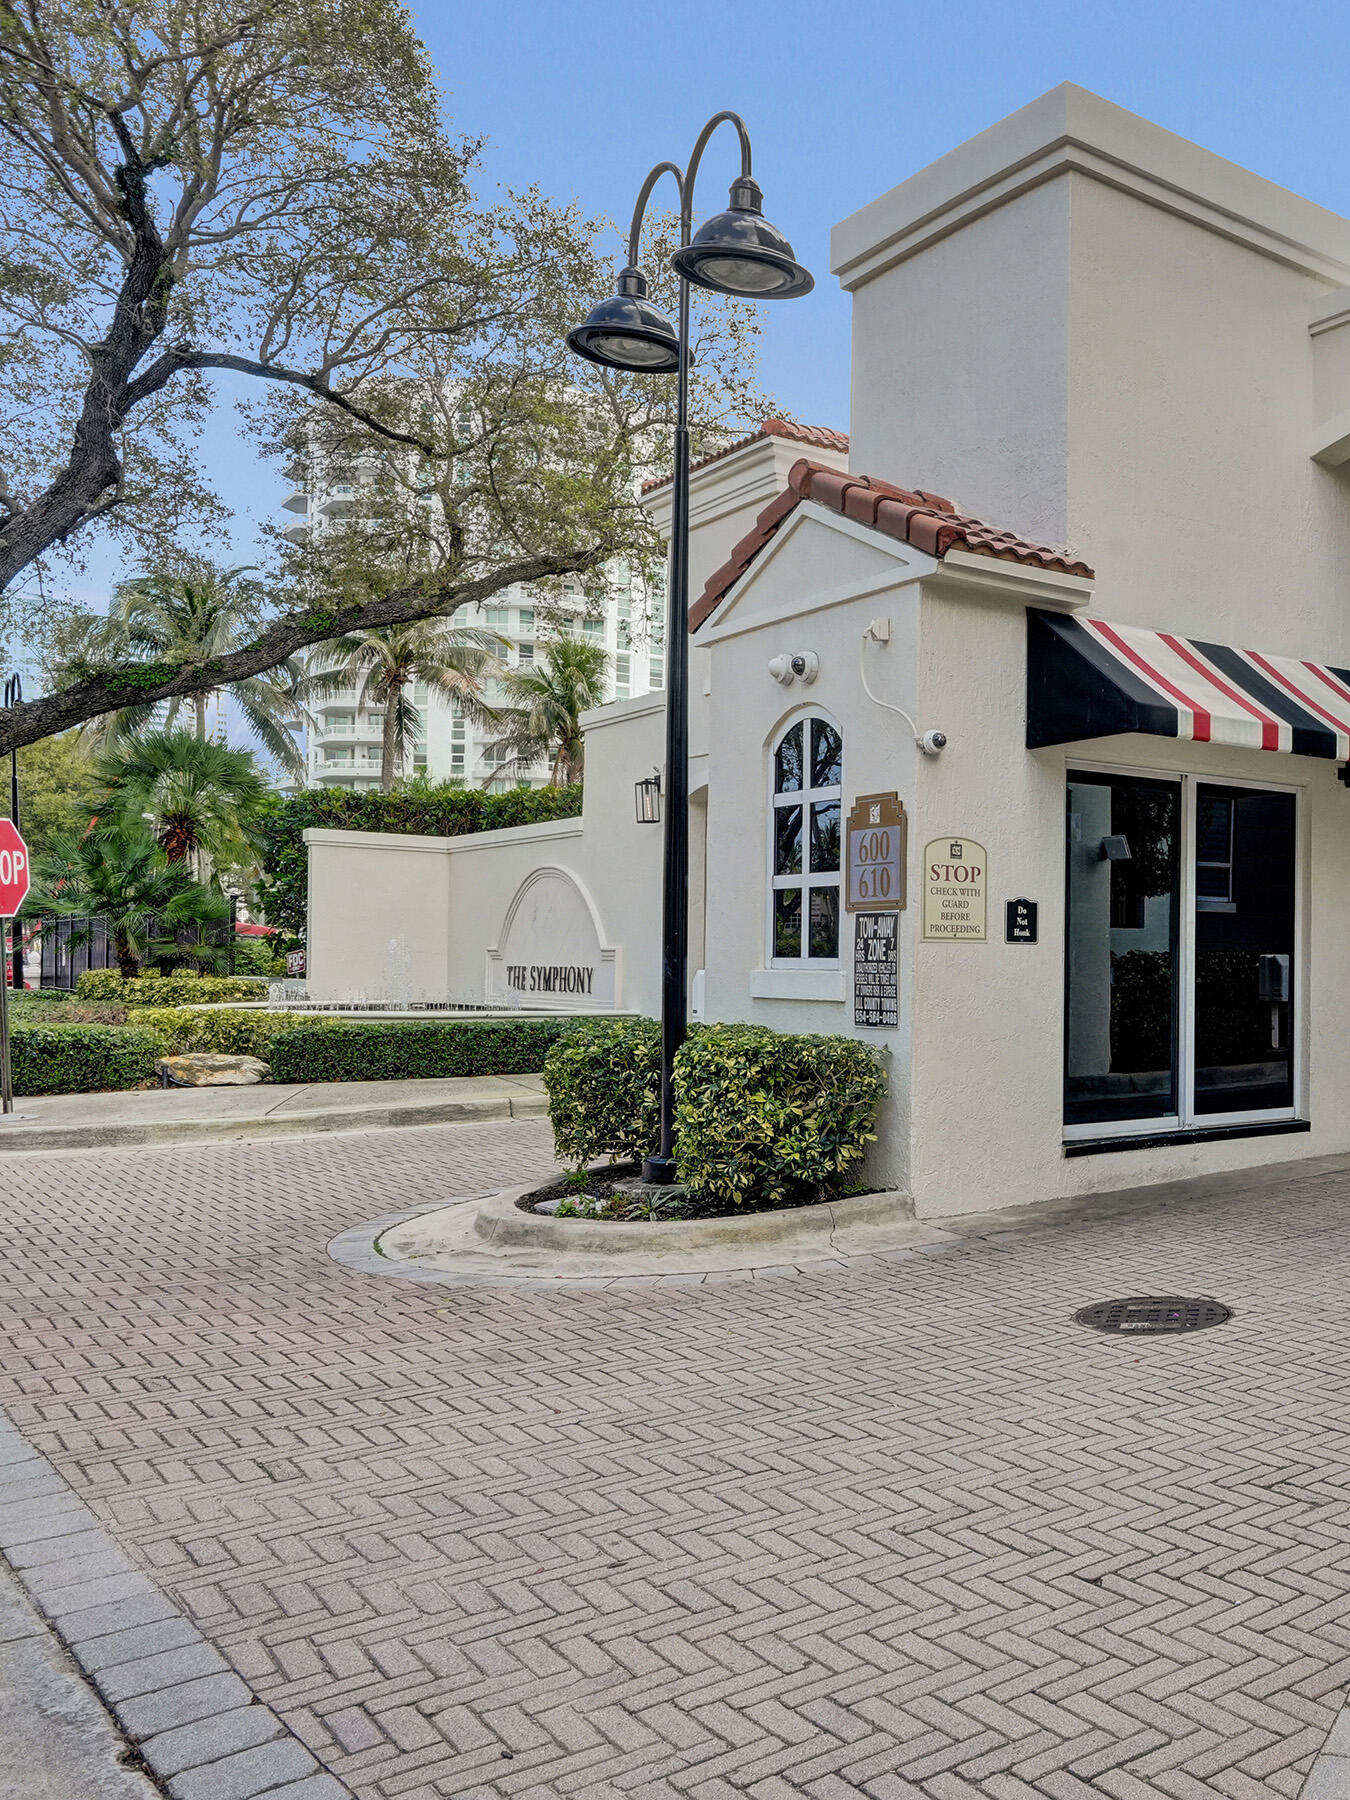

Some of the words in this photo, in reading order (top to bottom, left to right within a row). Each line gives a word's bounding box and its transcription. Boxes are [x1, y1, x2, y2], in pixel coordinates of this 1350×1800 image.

[859, 831, 890, 863] 600
[0, 850, 24, 885] OP
[930, 864, 982, 884] STOP
[859, 866, 890, 898] 610
[930, 887, 958, 896] CHECK
[959, 888, 980, 897] WITH
[942, 900, 969, 909] GUARD
[1018, 906, 1027, 914] Do
[940, 912, 970, 921] BEFORE
[1016, 917, 1028, 926] Not
[859, 916, 895, 938] TOW-AWAY
[930, 924, 980, 934] PROCEEDING
[1014, 928, 1030, 937] Honk
[856, 950, 865, 961] HRS
[857, 938, 864, 950] 24
[868, 940, 886, 961] ZONE
[890, 938, 895, 949] 7
[289, 951, 303, 967] FDC
[506, 966, 527, 991] THE
[530, 966, 593, 994] SYMPHONY
